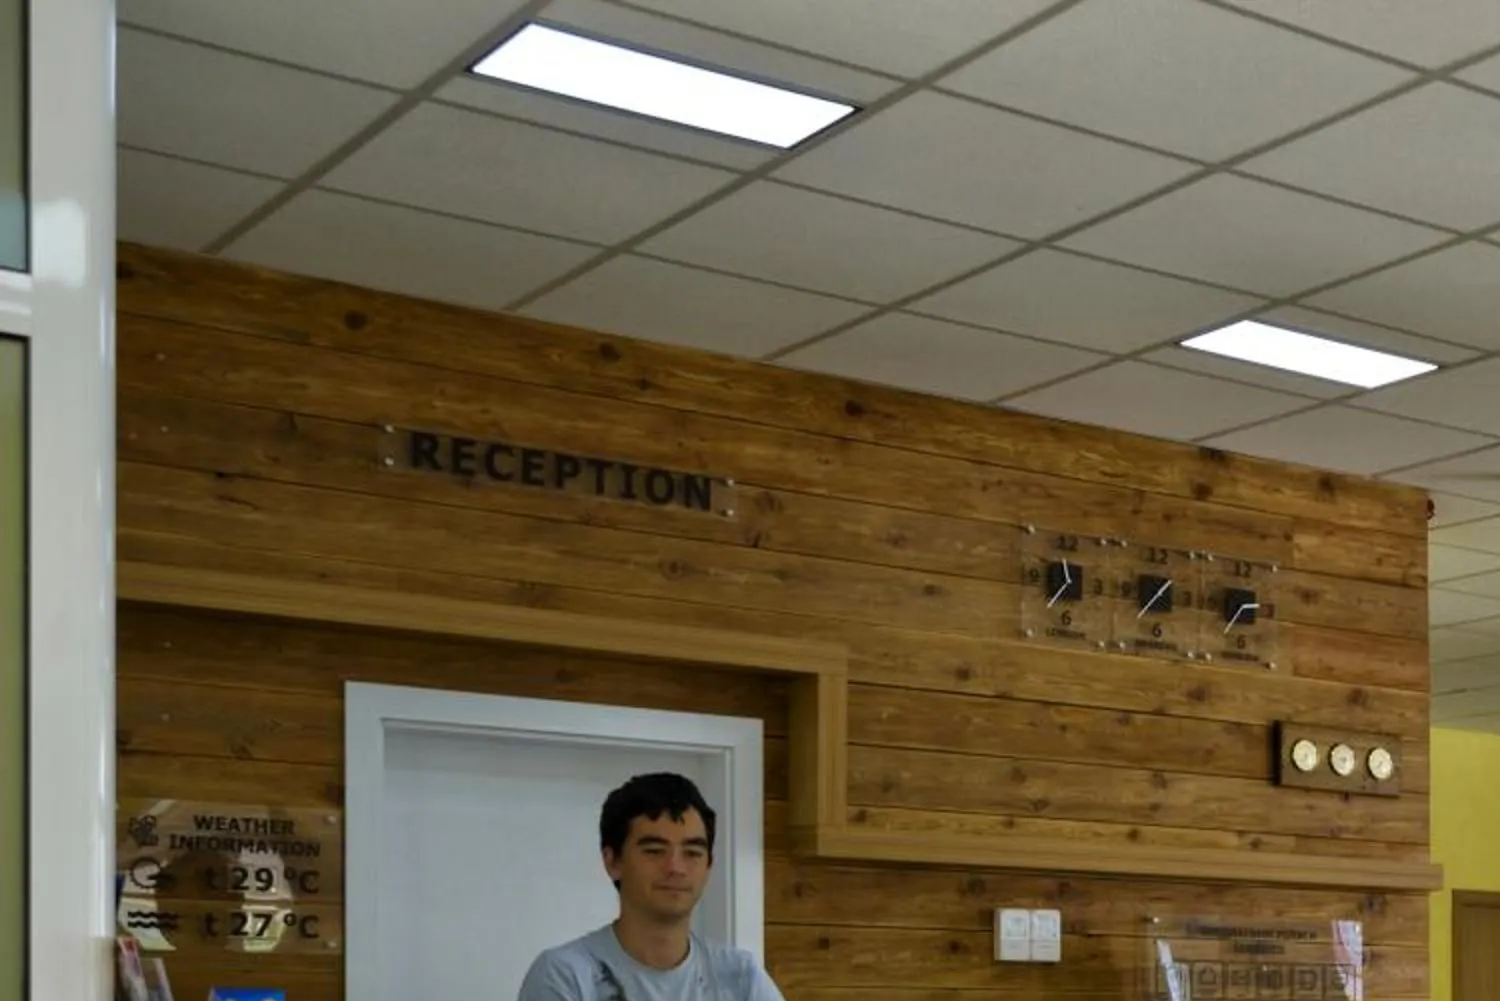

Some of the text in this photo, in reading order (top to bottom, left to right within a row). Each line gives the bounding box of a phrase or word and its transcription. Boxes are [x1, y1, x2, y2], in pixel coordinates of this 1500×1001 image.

[409, 431, 711, 512] RECEPTION
[1147, 547, 1168, 565] 12
[1061, 610, 1072, 626] 6
[1152, 623, 1162, 638] 6
[1236, 634, 1247, 649] 6
[193, 815, 295, 835] WEATHER
[169, 834, 321, 857] INFORMATION
[231, 867, 274, 893] 29
[205, 914, 219, 936] t
[231, 912, 273, 937] 27
